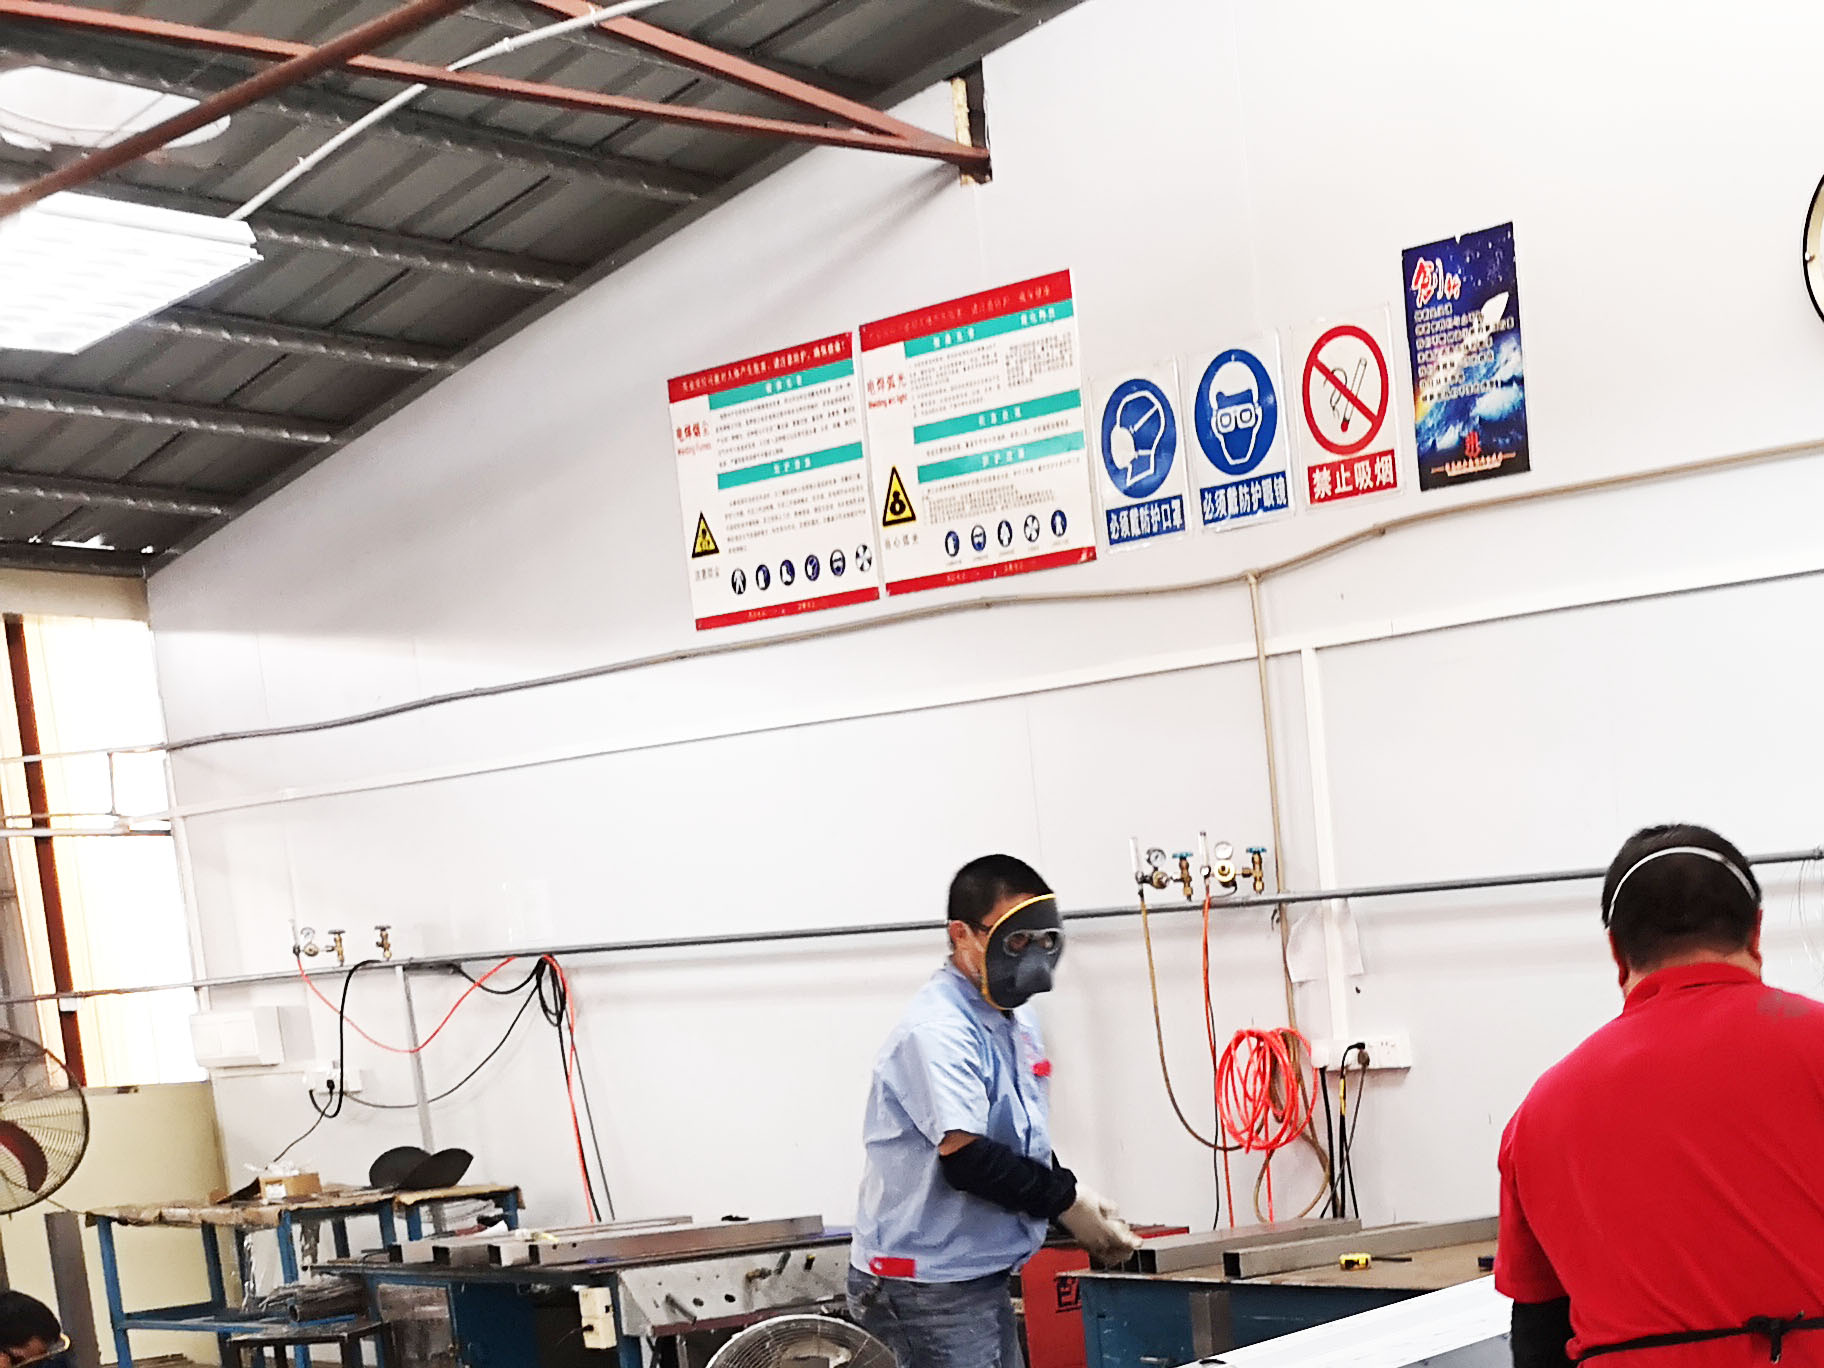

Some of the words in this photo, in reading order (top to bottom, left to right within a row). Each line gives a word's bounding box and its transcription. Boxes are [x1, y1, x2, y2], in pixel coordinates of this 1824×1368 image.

[1203, 475, 1288, 521] 必须戴防护眼镜
[1312, 456, 1395, 499] 禁止吸烟
[1110, 499, 1183, 540] 必须戴防护口罩
